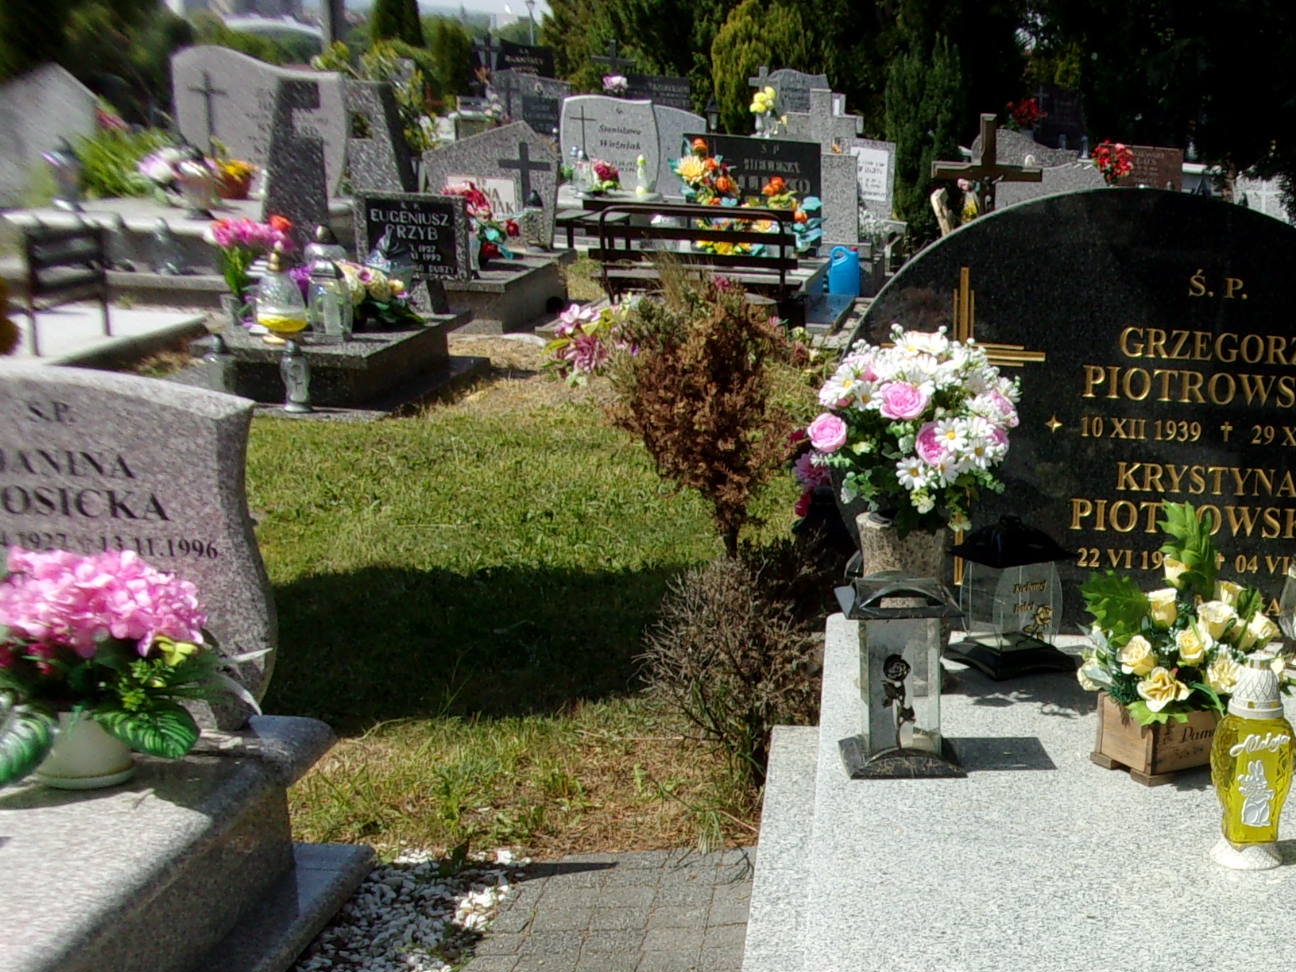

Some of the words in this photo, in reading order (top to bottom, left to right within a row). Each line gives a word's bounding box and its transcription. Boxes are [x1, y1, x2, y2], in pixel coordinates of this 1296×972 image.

[370, 208, 450, 226] EUGENIUSZ
[1188, 269, 1214, 298] Ś.
[1224, 277, 1248, 299] P.
[1080, 416, 1103, 438] 10
[1110, 417, 1146, 440] XII
[1154, 420, 1202, 442] 1939
[1250, 424, 1279, 446] 29
[1077, 547, 1100, 568] 22
[1107, 549, 1133, 569] VI
[1141, 551, 1164, 571] 19
[1234, 554, 1259, 574] 04
